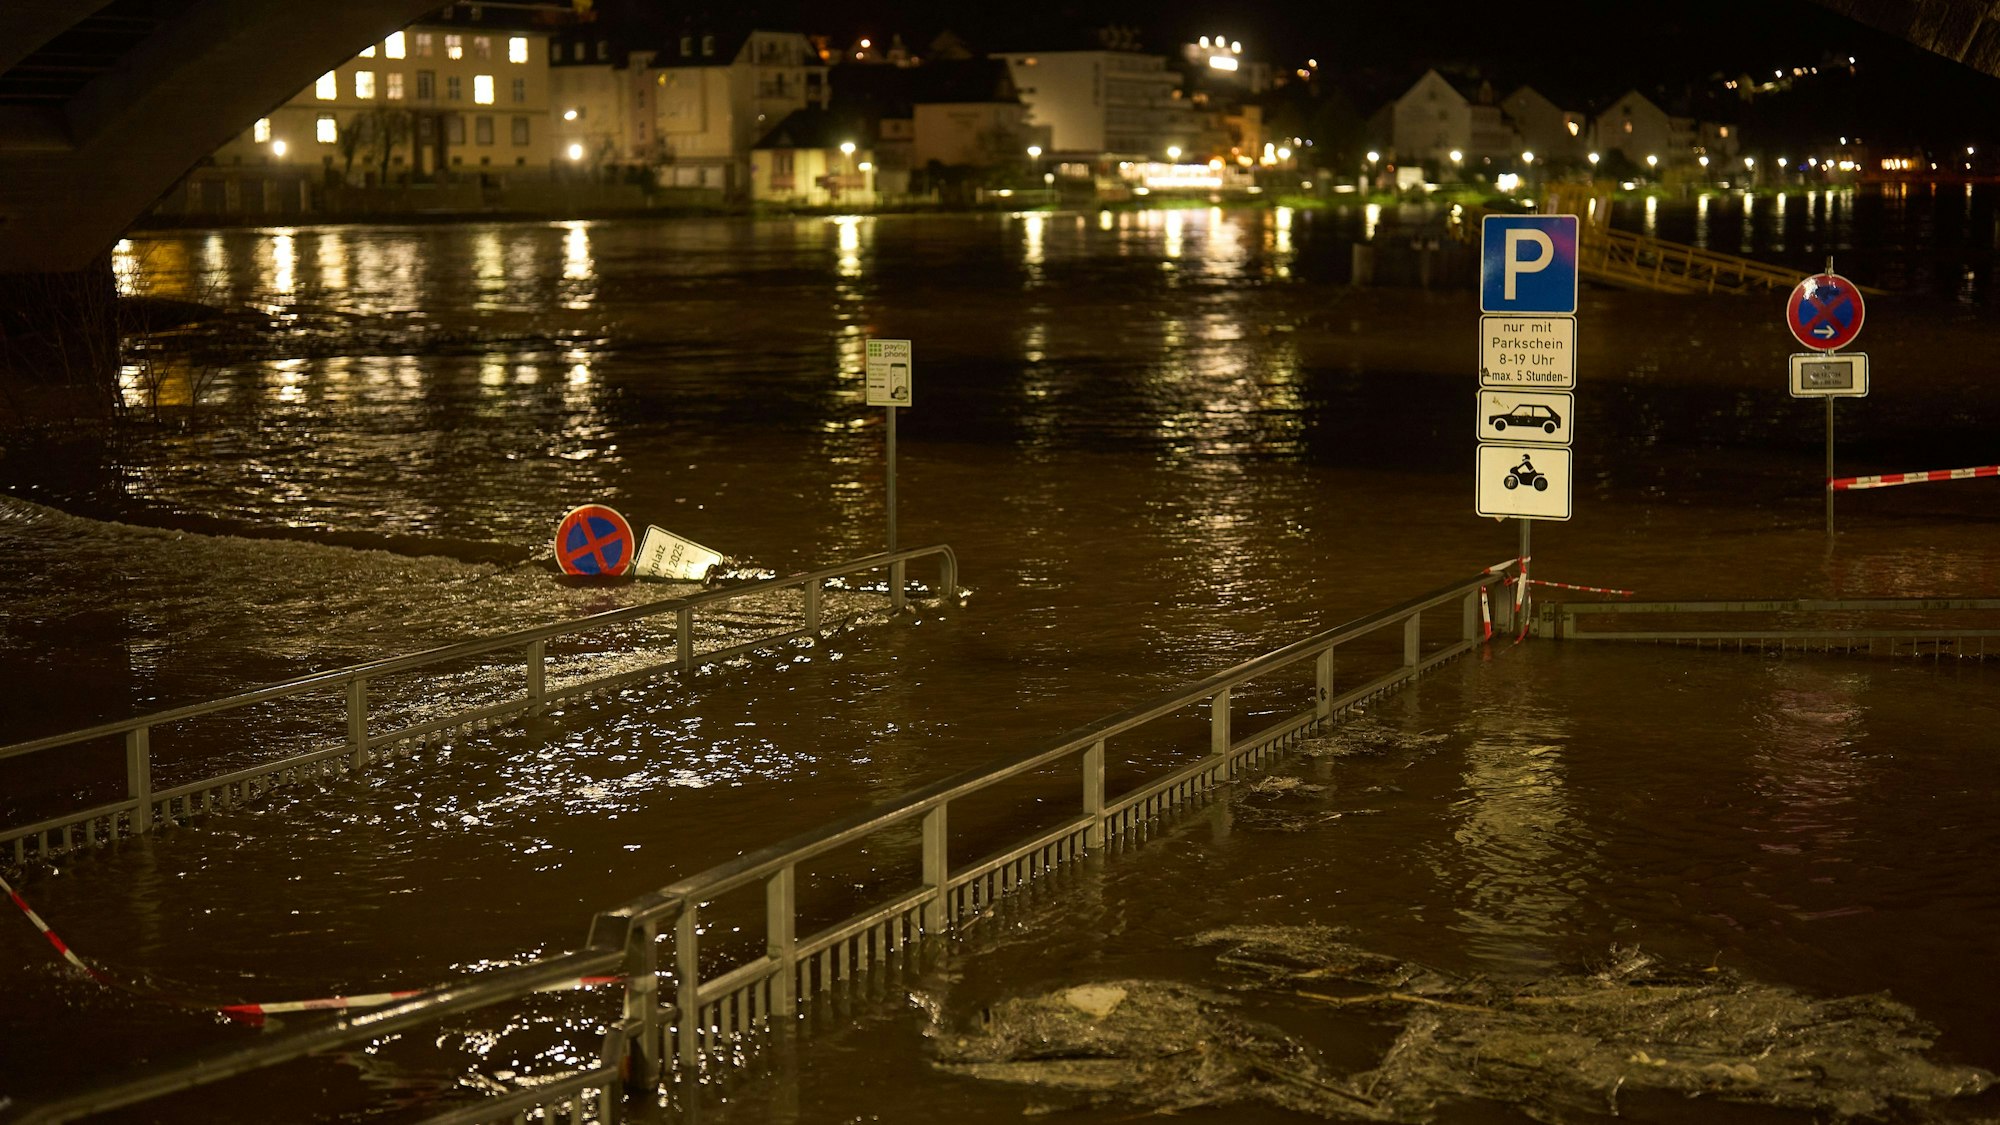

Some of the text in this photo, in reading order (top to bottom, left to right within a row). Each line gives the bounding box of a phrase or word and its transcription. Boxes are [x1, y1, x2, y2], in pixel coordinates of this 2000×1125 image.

[1504, 228, 1554, 300] P
[1503, 321, 1552, 333] nur mit
[1492, 337, 1563, 350] Parkschein
[1499, 353, 1555, 366] 8-19 Uhr
[1517, 370, 1523, 382] 5
[647, 544, 667, 577] kplatz
